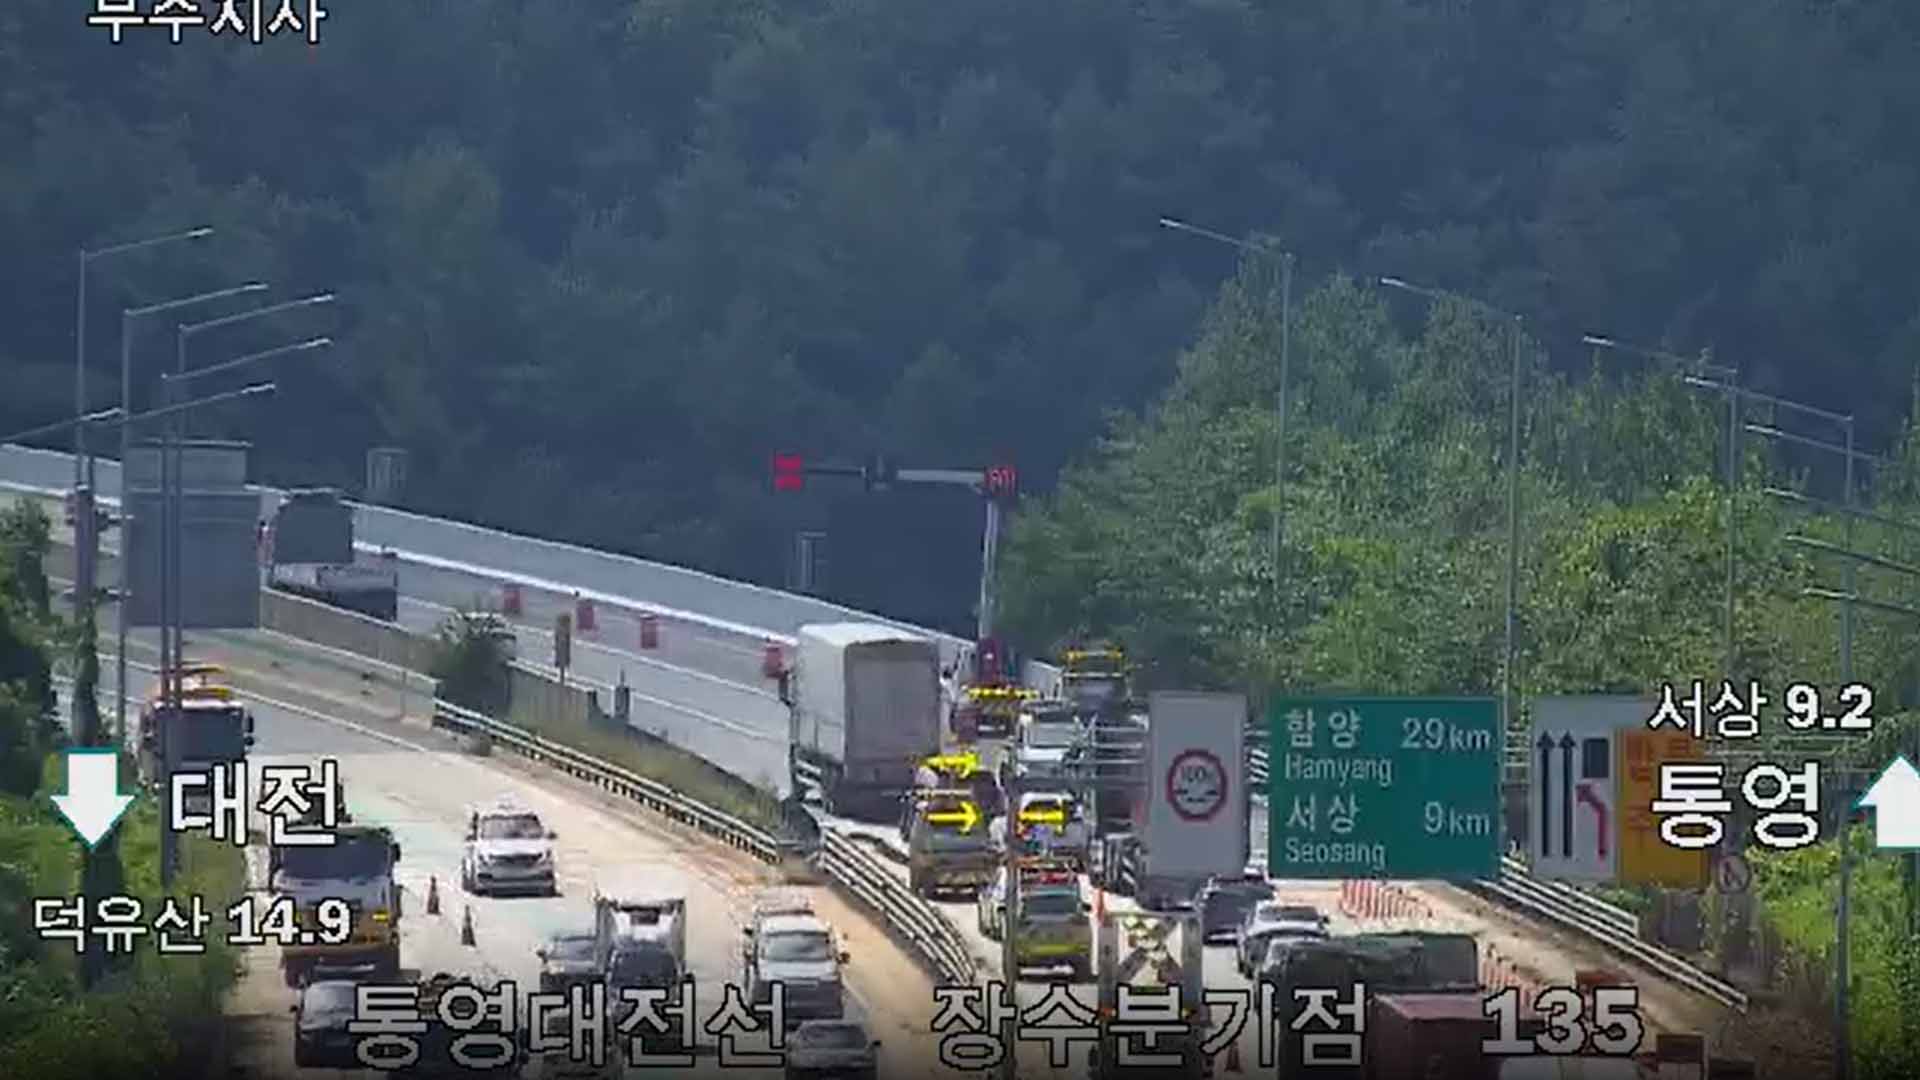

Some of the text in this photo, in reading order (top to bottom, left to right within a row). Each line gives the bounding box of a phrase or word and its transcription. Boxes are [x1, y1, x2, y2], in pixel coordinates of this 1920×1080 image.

[1285, 708, 1362, 748] 함양
[1285, 754, 1392, 787] Hamyang
[1286, 795, 1360, 833] 서상
[1285, 838, 1386, 871] Seosang
